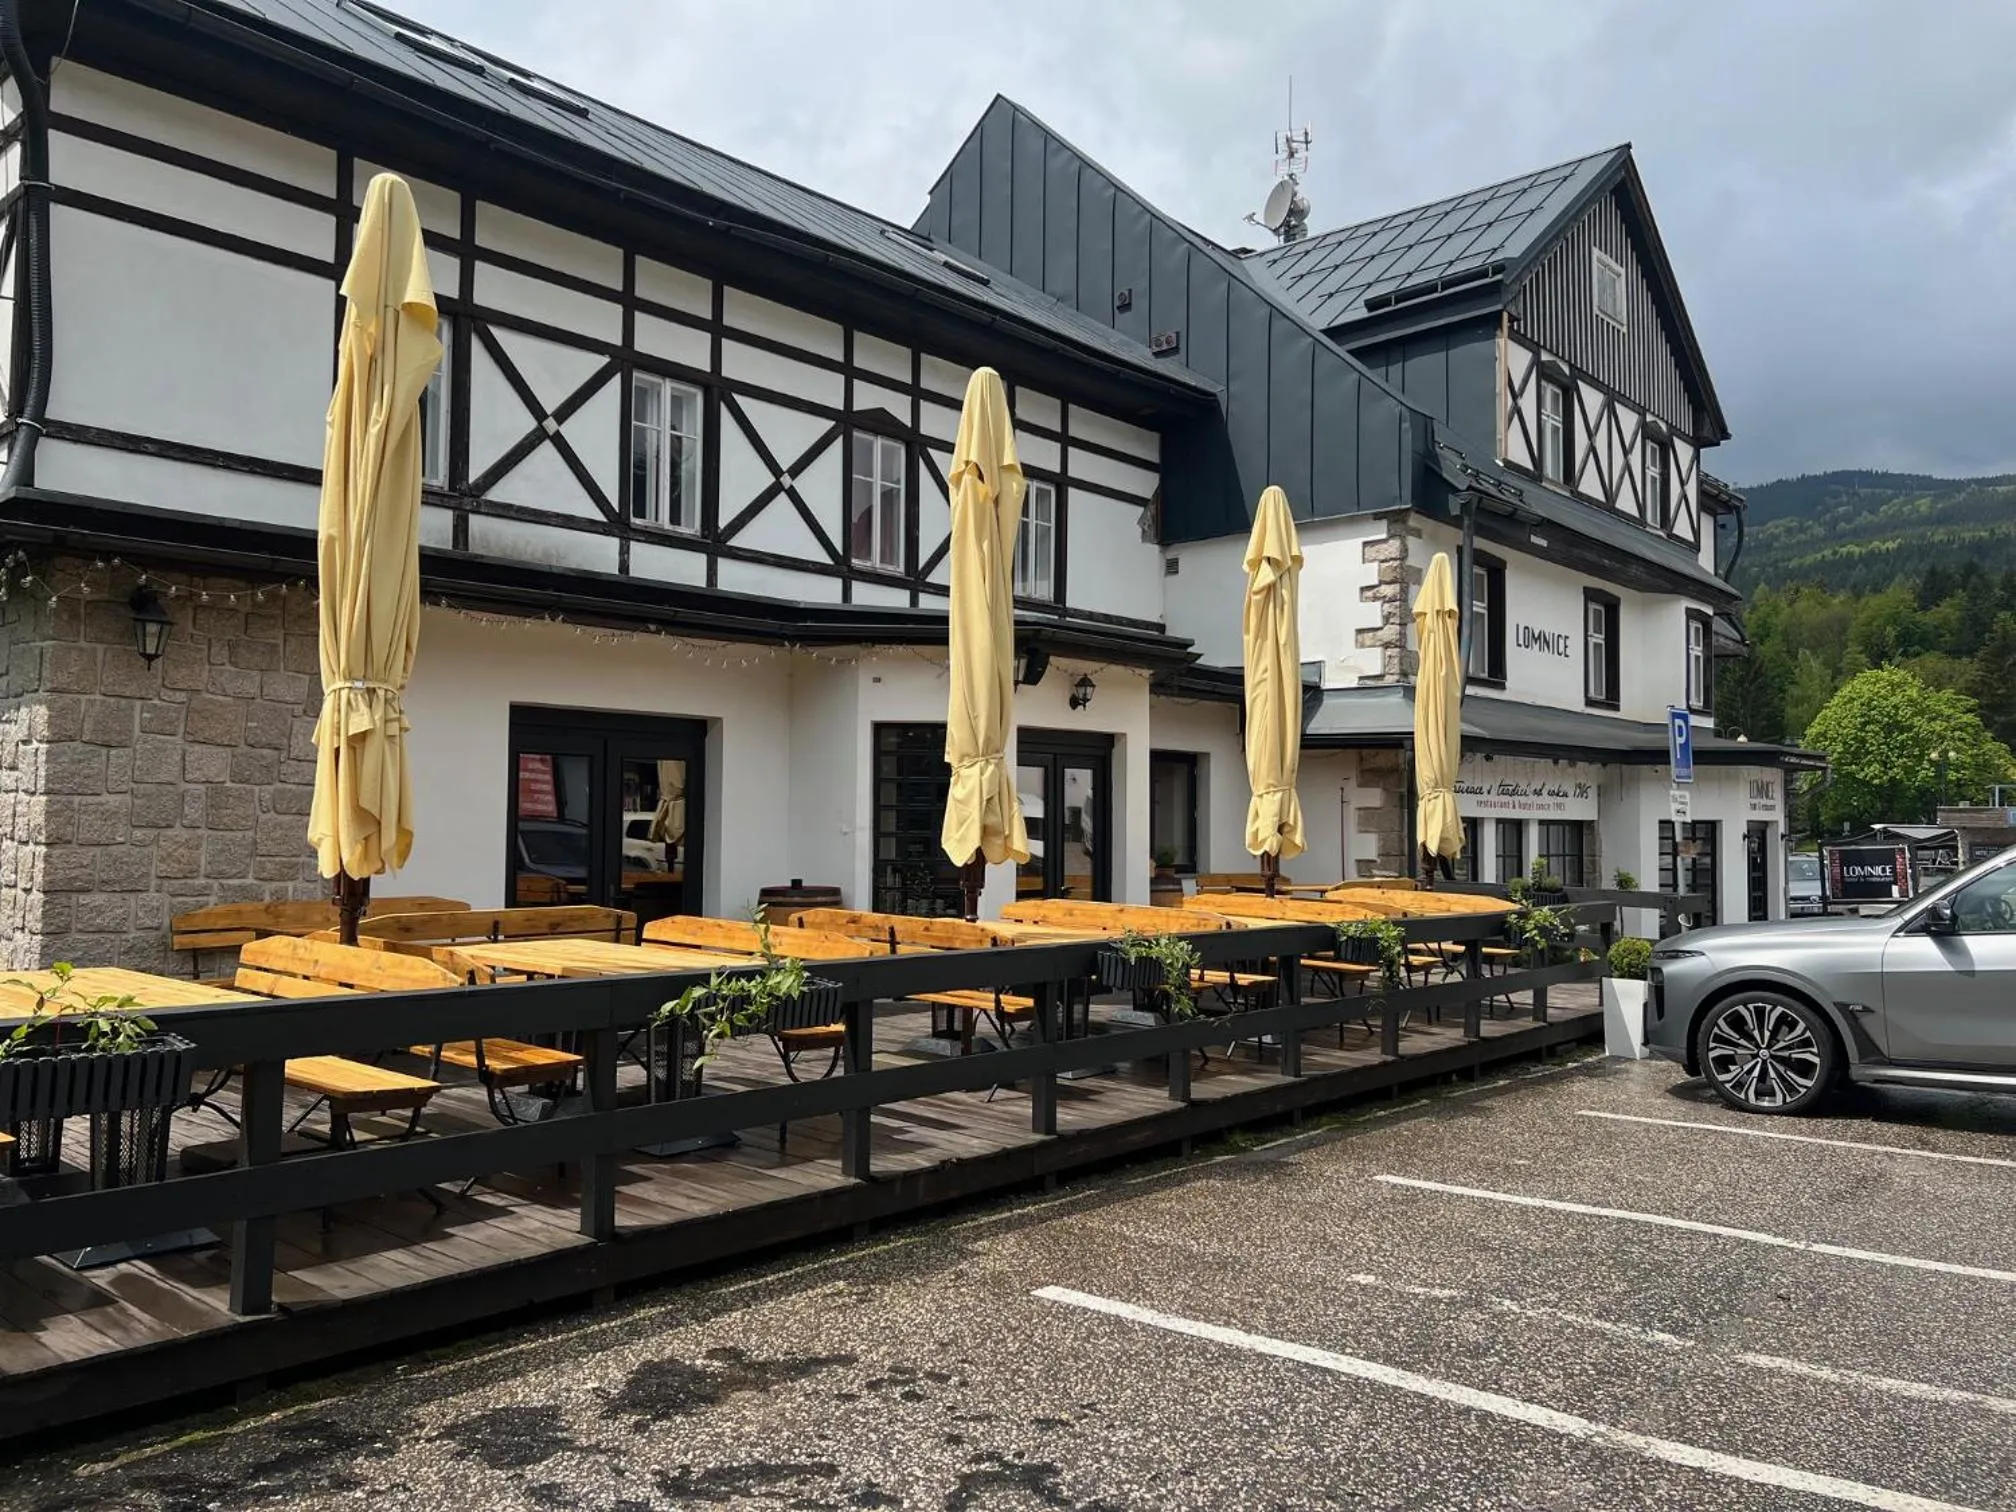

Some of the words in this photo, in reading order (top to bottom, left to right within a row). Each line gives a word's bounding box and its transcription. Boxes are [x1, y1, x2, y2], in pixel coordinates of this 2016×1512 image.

[1515, 623, 1570, 658] LOMNICE
[1674, 718, 1687, 759] P
[1843, 864, 1893, 877] LOMNICE
